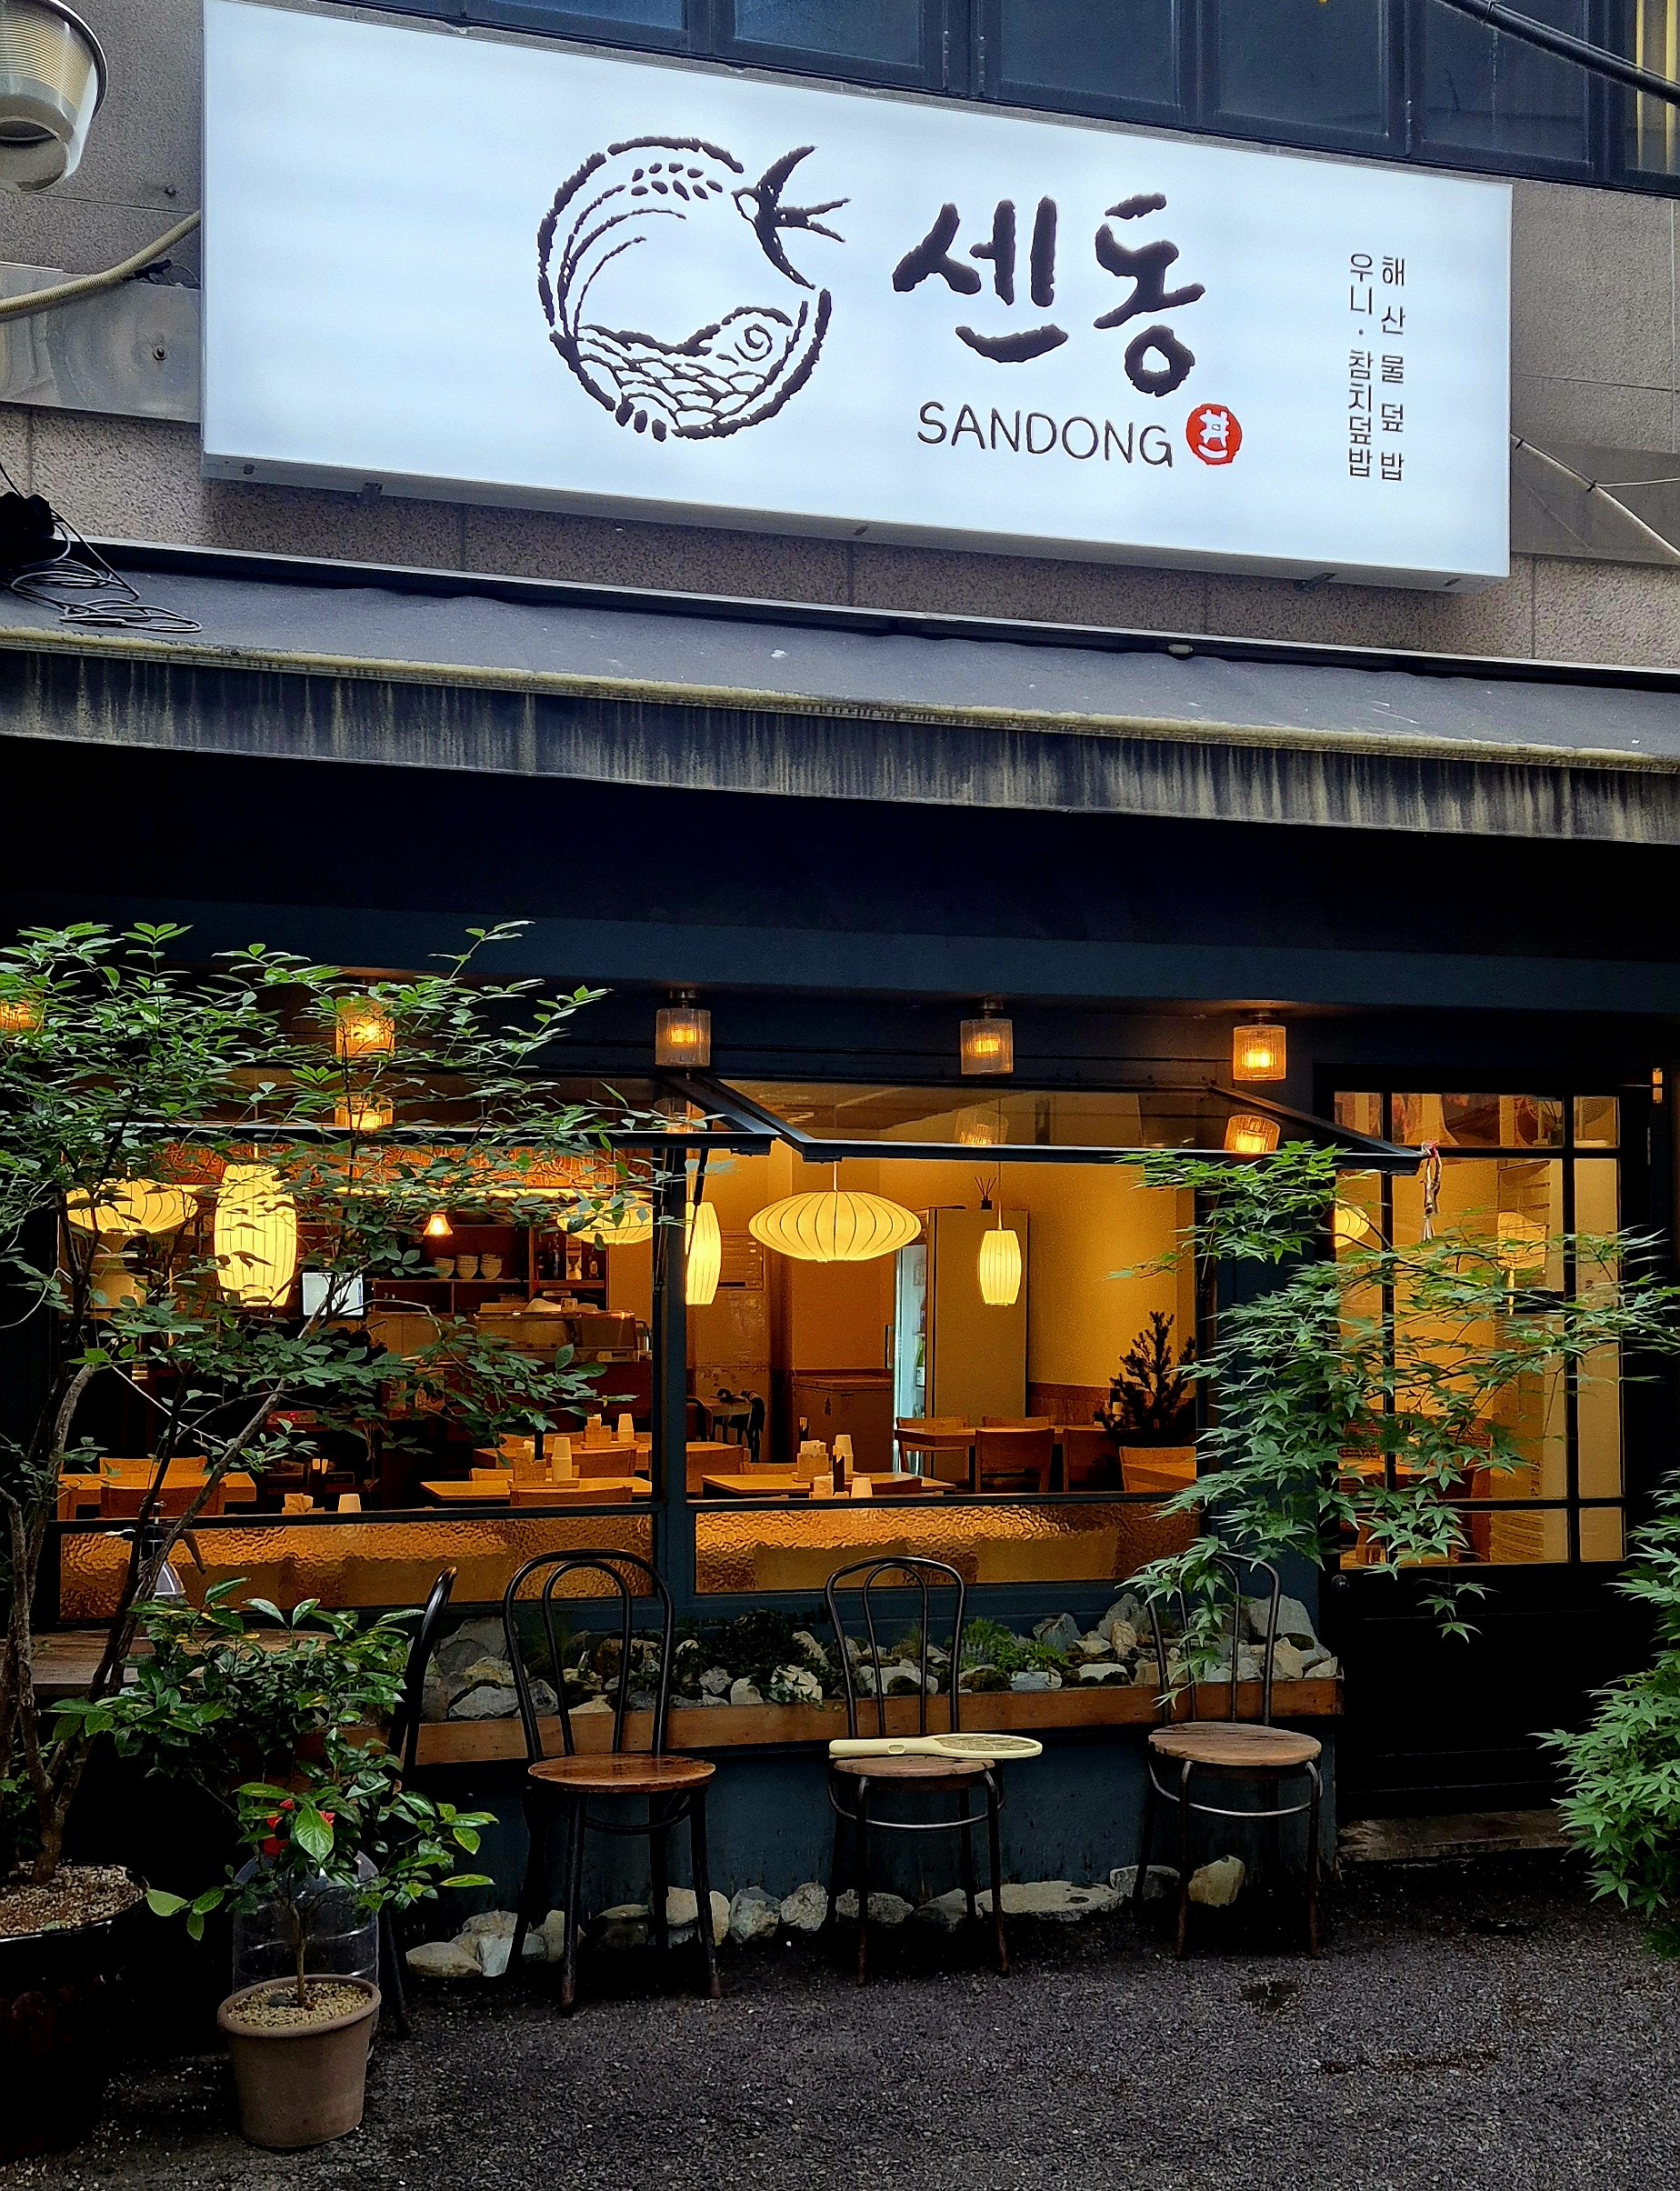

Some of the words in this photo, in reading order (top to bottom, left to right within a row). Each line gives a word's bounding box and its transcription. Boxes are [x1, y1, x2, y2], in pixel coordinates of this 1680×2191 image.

[892, 194, 1205, 397] 센동
[1380, 255, 1406, 482] 해산물덮밥
[917, 401, 1173, 468] SANDONG
